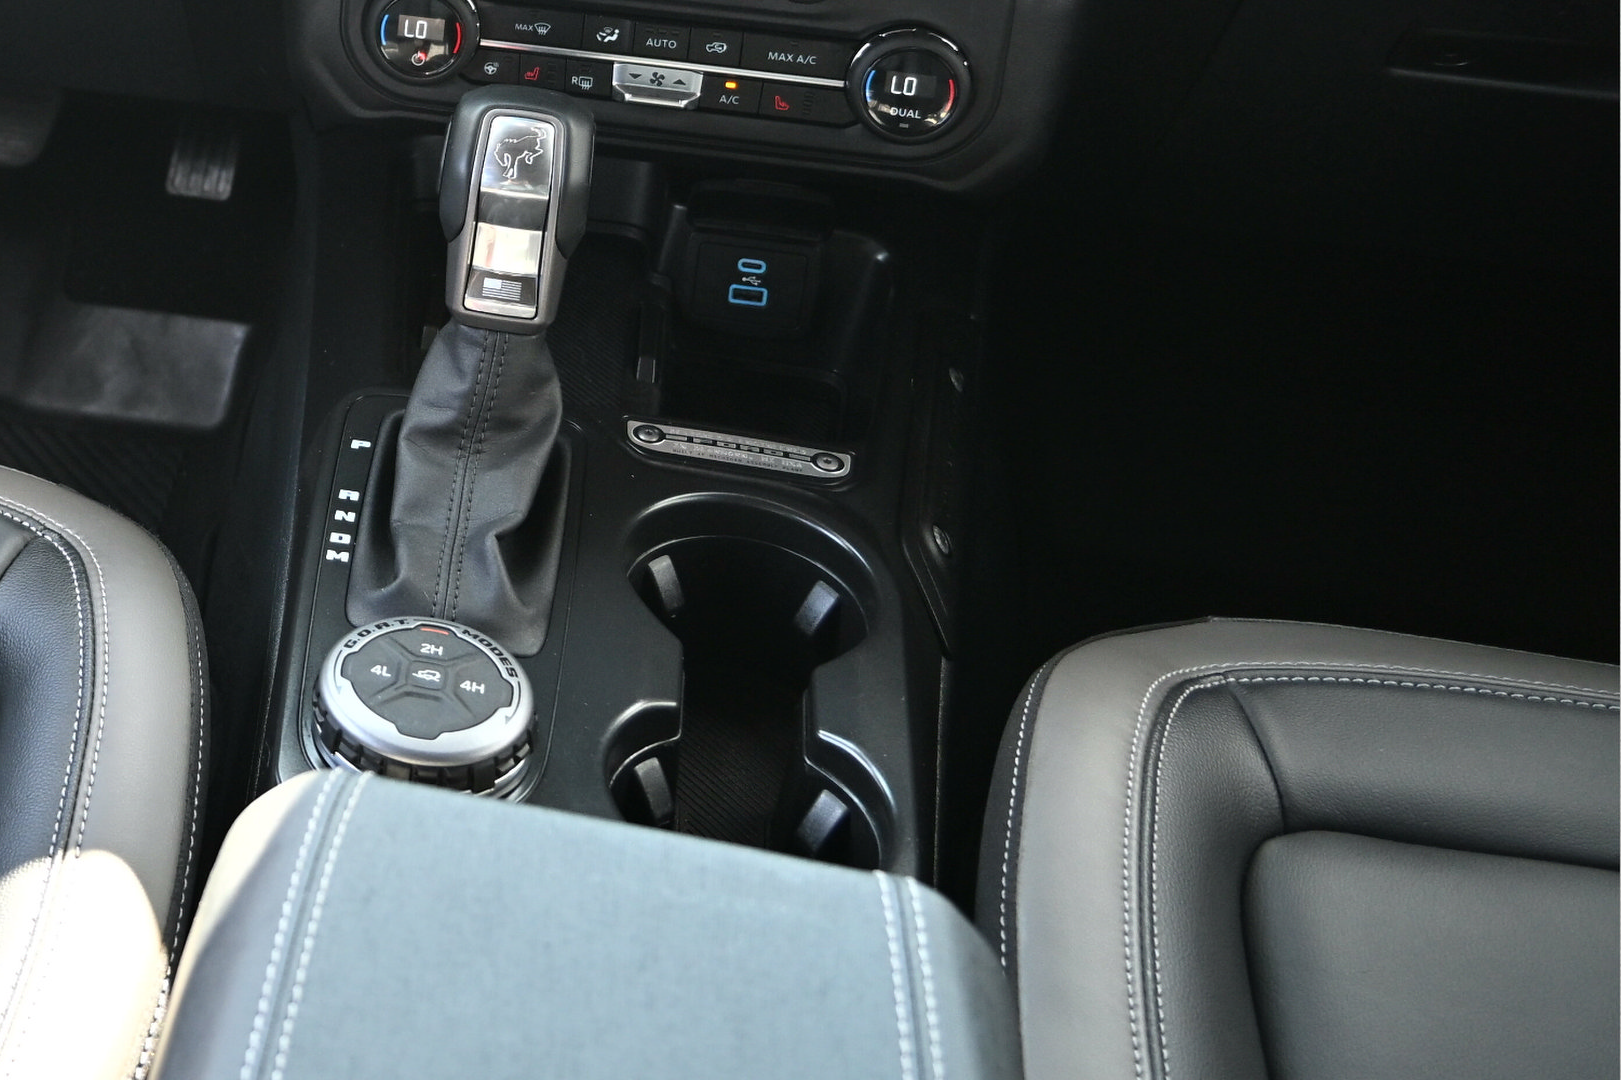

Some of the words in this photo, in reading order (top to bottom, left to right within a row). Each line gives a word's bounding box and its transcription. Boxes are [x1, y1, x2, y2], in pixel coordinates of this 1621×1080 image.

[403, 19, 428, 39] LO
[514, 23, 534, 32] MAX
[645, 38, 677, 49] AUTO
[767, 51, 793, 63] MAX
[796, 54, 817, 65] A/C
[890, 76, 917, 97] LO
[718, 94, 740, 105] A/C
[890, 107, 921, 119] DUAL
[350, 438, 372, 450] P
[338, 488, 360, 501] R
[333, 509, 356, 523] N
[329, 531, 352, 545] D
[325, 549, 350, 563] M
[419, 642, 444, 657] 2H
[461, 628, 519, 679] MODES
[369, 664, 392, 678] 4L
[458, 679, 486, 694] 4H
